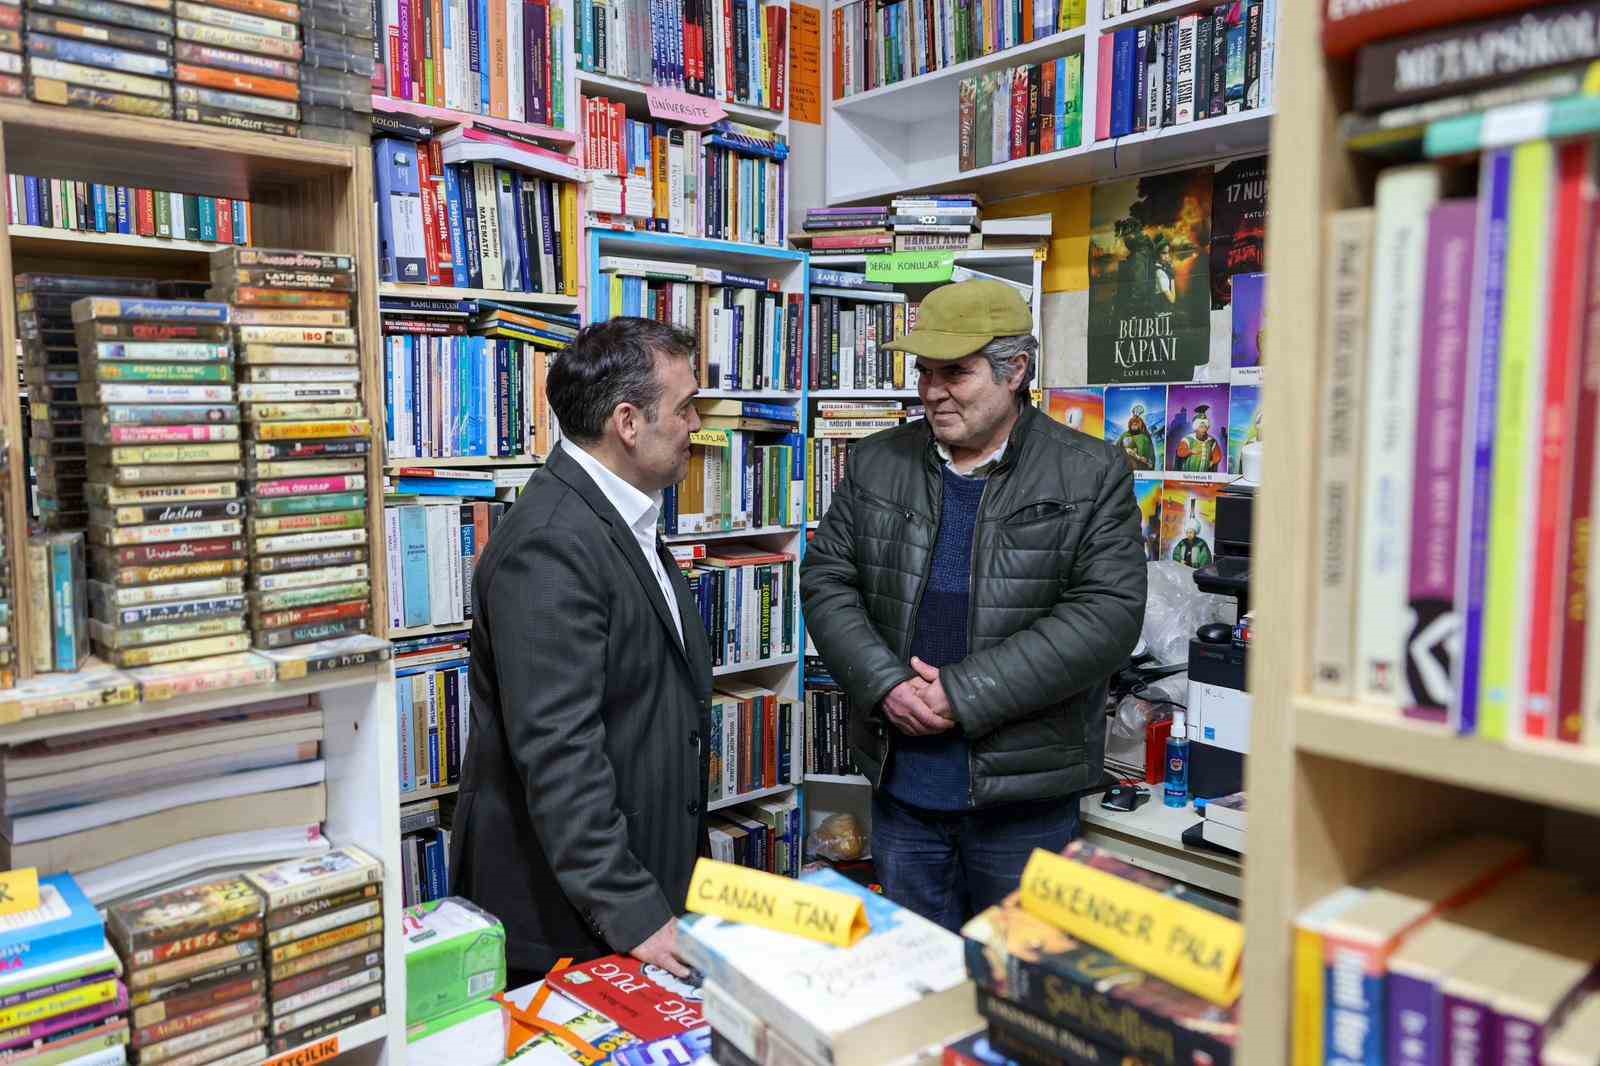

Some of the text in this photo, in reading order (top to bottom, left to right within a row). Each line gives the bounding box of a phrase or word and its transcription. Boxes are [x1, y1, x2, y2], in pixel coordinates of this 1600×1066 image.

[1119, 314, 1174, 339] BÜLBÜL
[1114, 337, 1177, 368] KAPANI
[698, 878, 840, 934] CANAN TAN
[1030, 868, 1226, 973] İSKENDER PALA
